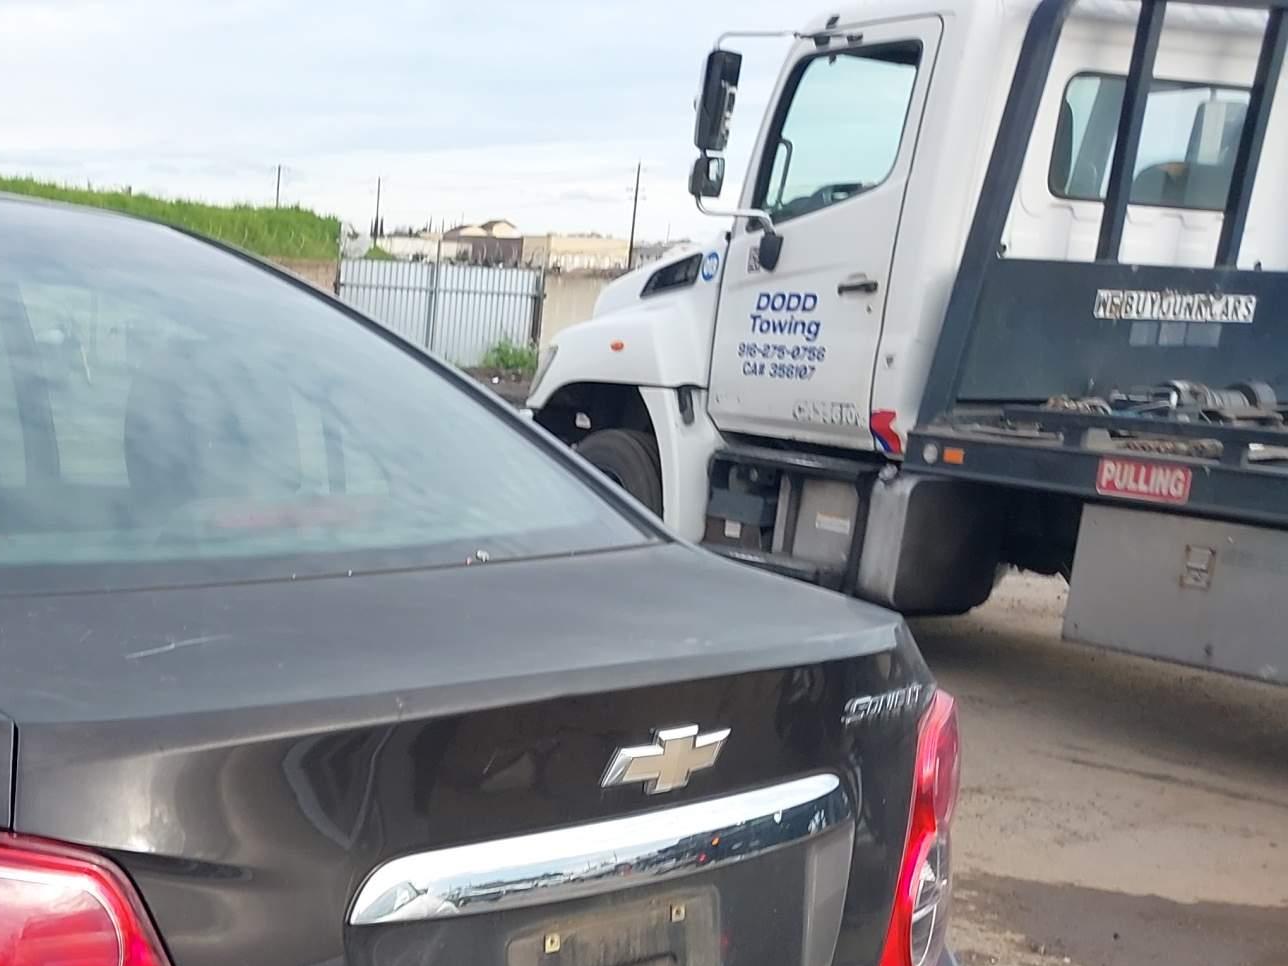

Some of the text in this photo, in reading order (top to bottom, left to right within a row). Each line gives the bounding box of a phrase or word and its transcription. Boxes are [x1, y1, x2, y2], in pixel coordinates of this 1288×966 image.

[756, 292, 819, 313] DODD
[1123, 291, 1160, 320] BUY
[750, 315, 821, 342] Towing
[1101, 461, 1187, 497] PULLING
